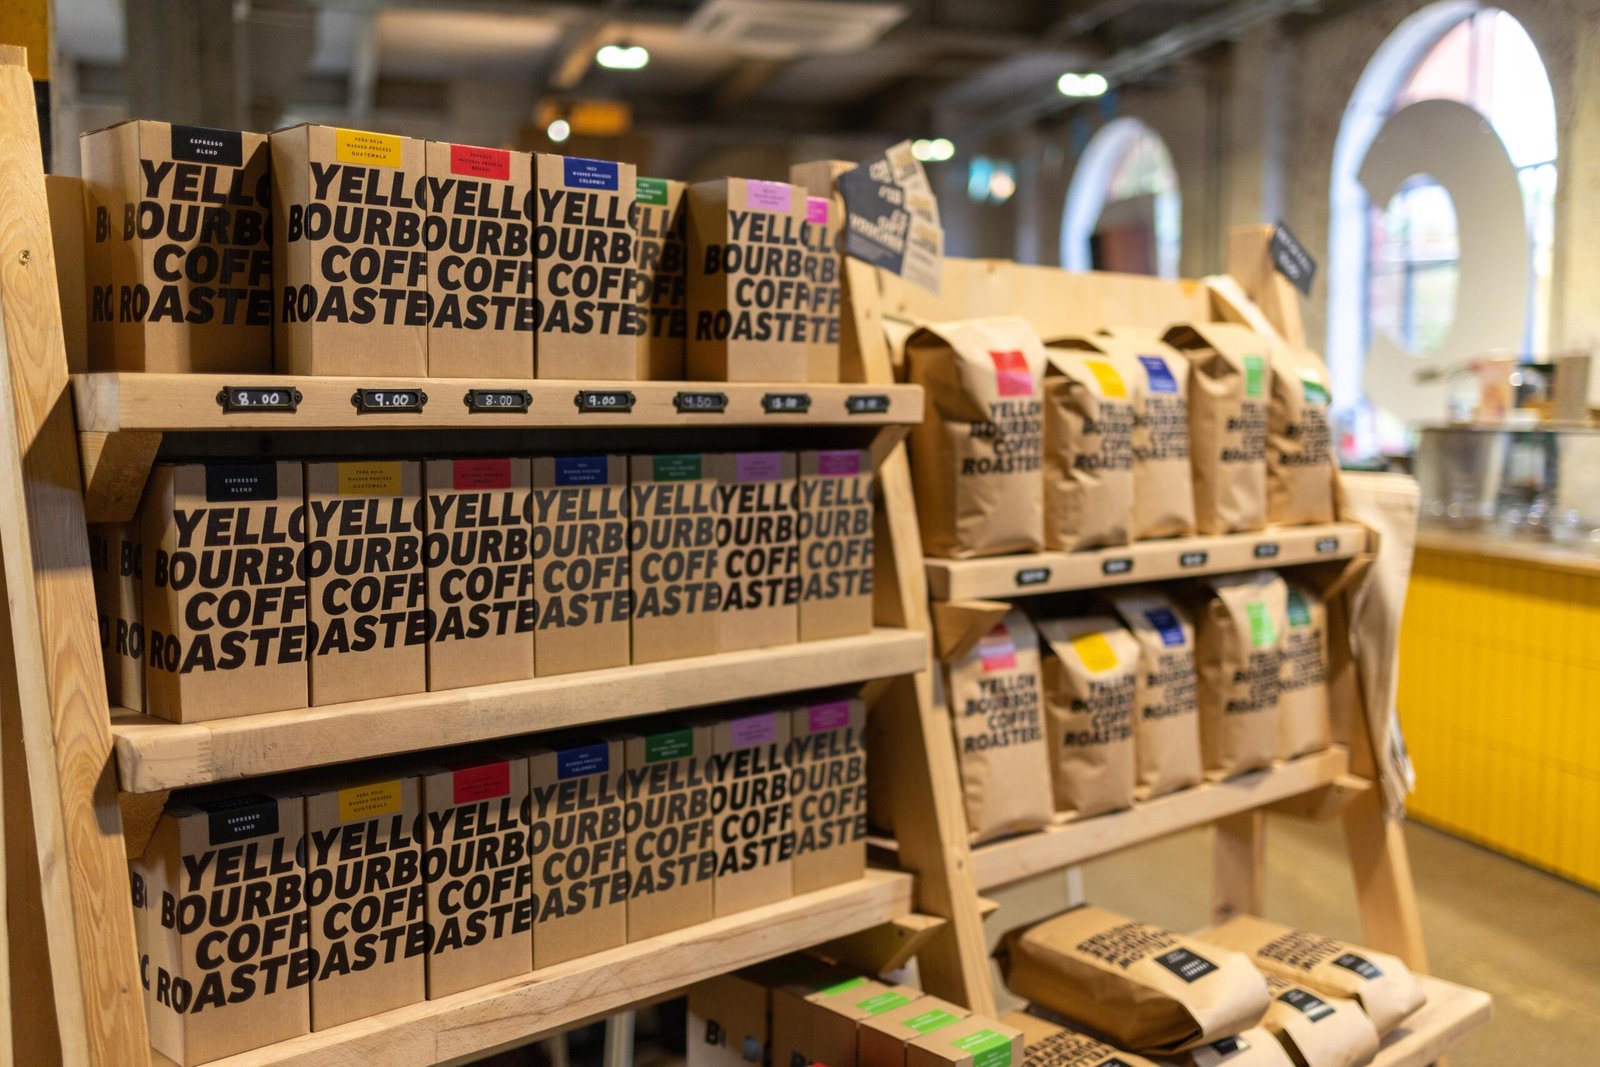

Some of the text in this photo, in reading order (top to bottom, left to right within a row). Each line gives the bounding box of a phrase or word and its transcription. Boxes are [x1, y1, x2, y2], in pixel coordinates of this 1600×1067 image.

[190, 138, 223, 147] ESPRESSO
[197, 148, 217, 156] BLEND
[352, 151, 386, 159] GUATEMALA
[123, 201, 272, 248] BOURB
[288, 203, 426, 250] BOURB
[425, 215, 533, 257] OURB
[537, 225, 636, 264] OURB
[153, 244, 273, 286] COFF
[321, 245, 427, 287] COFF
[438, 255, 534, 294] COFF
[548, 264, 637, 300] COFF
[238, 392, 279, 406] 8.00
[375, 393, 409, 407] 9.00
[485, 395, 513, 406] 8.00
[589, 395, 616, 406] 9.00
[307, 536, 423, 578] OURB
[426, 528, 531, 568] OURB
[532, 522, 625, 558] OURB
[155, 547, 306, 591] BOURB
[440, 564, 533, 604] COFF
[543, 556, 629, 593] COFF
[185, 586, 306, 631] COFF
[322, 573, 424, 616] COFF
[228, 814, 260, 824] ESPRESSO
[234, 824, 255, 832] BLEND
[307, 850, 423, 906] OURB
[424, 832, 531, 883] OURB
[543, 838, 626, 886] COFF
[162, 874, 307, 935] BOURB
[438, 864, 531, 916] COFF
[323, 885, 424, 940] COFF
[196, 911, 308, 970] COFF
